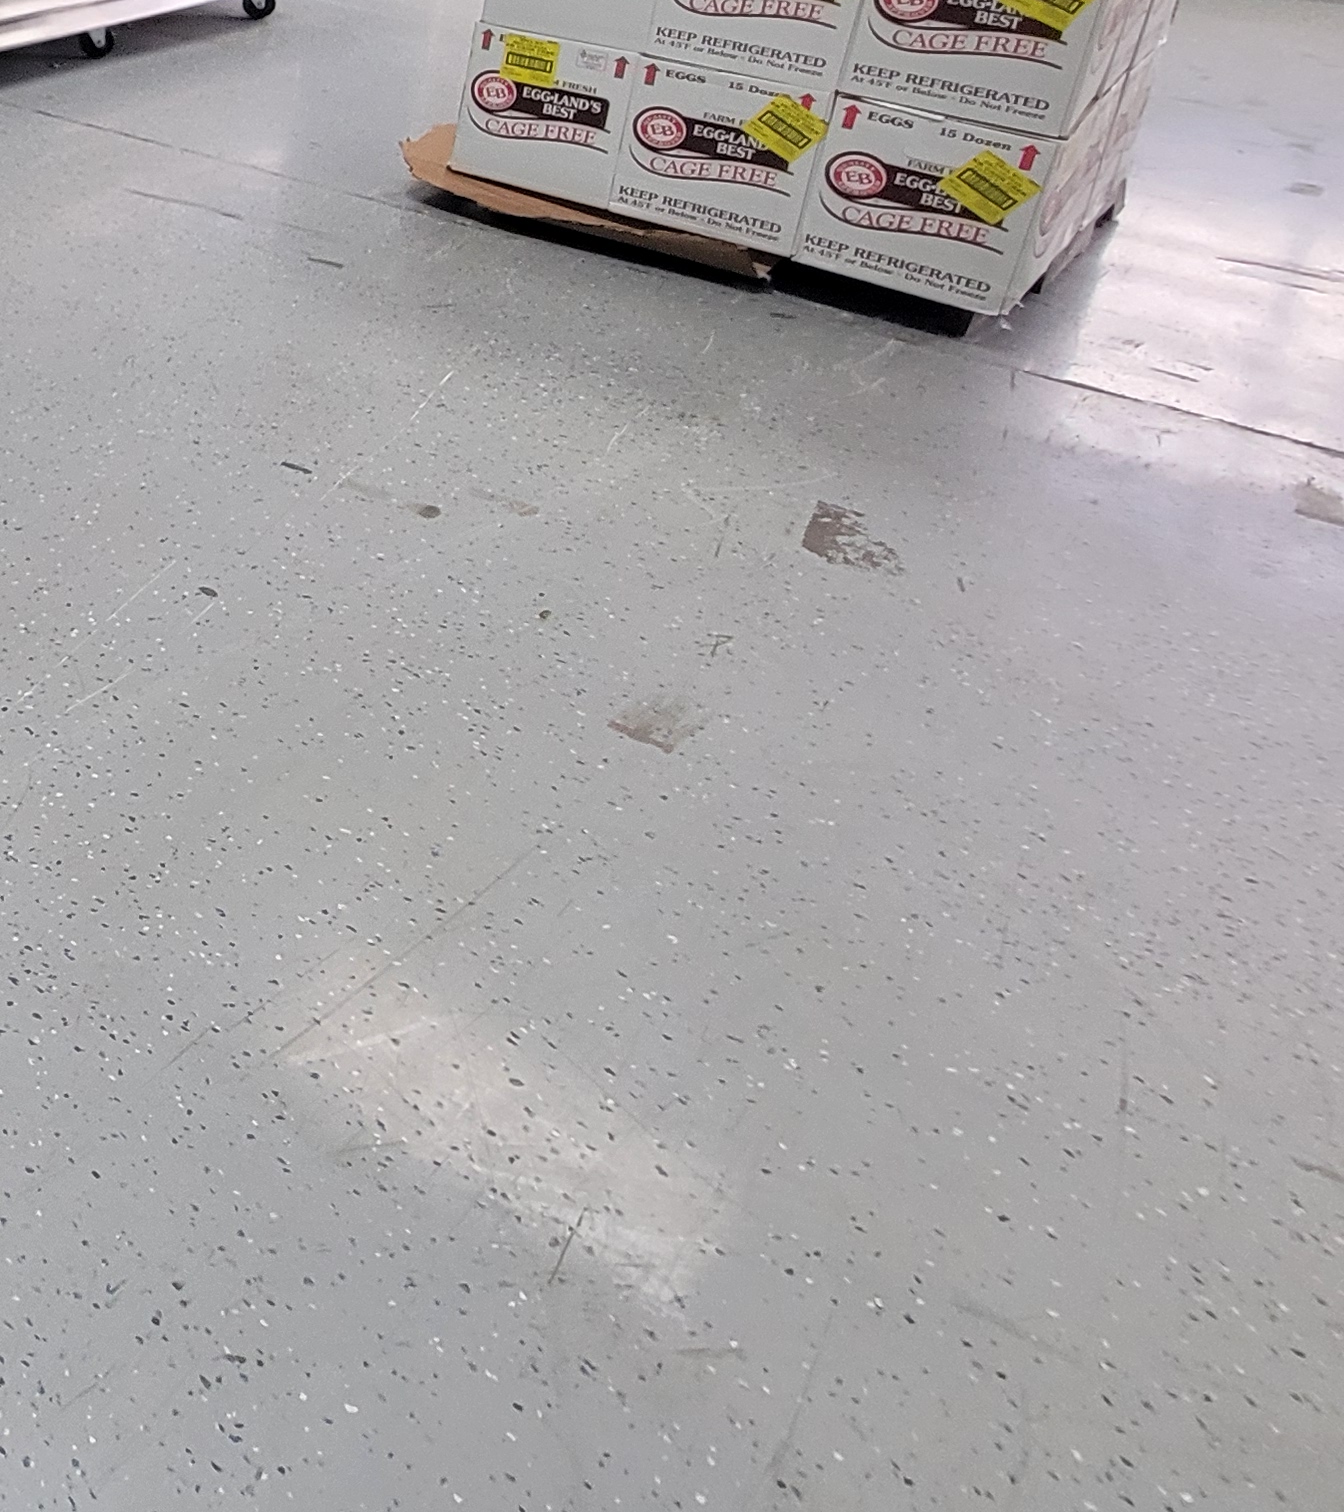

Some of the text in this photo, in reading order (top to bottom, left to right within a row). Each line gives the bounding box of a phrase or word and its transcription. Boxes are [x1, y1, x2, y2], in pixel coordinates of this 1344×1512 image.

[761, 0, 825, 20] FREE
[974, 10, 1022, 30] BEST
[654, 37, 665, 45] At
[707, 47, 738, 60] Below
[747, 56, 764, 64] Do
[766, 59, 785, 70] Not
[788, 63, 824, 77] Freeze
[656, 26, 827, 69] KEEP REFRIGERATED
[892, 29, 1048, 58] CAGE FREE
[486, 87, 506, 99] EB
[666, 69, 706, 84] EGGS
[729, 81, 744, 91] 15
[853, 63, 1050, 111] KEEP REFRIGERATED
[851, 74, 865, 83] At
[912, 86, 948, 101] Below
[959, 95, 977, 105] Do
[980, 99, 1002, 111] Not
[1005, 102, 1047, 120] Freeze
[543, 104, 577, 120] BEST
[703, 112, 736, 125] FARM
[485, 118, 596, 144] CAGE FREE
[649, 122, 674, 137] EB
[867, 111, 1012, 151] EGGS 15 Dozen
[716, 141, 756, 160] BEST
[649, 156, 778, 186] CAGE FREE
[845, 169, 873, 185] EB
[907, 158, 945, 173] FARM
[618, 196, 629, 204] At
[668, 207, 697, 222] Below
[707, 217, 722, 227] Do
[725, 221, 743, 233] Not
[745, 227, 779, 242] Freeze
[619, 185, 781, 234] KEEP REFRIGERATED
[841, 206, 990, 244] CAGE FREE
[803, 245, 815, 253] At
[859, 260, 894, 276] Below
[904, 273, 920, 284] Do
[925, 279, 944, 290] Not
[948, 282, 987, 301] Freeze
[805, 233, 991, 293] KEEP REFRIGERATED
